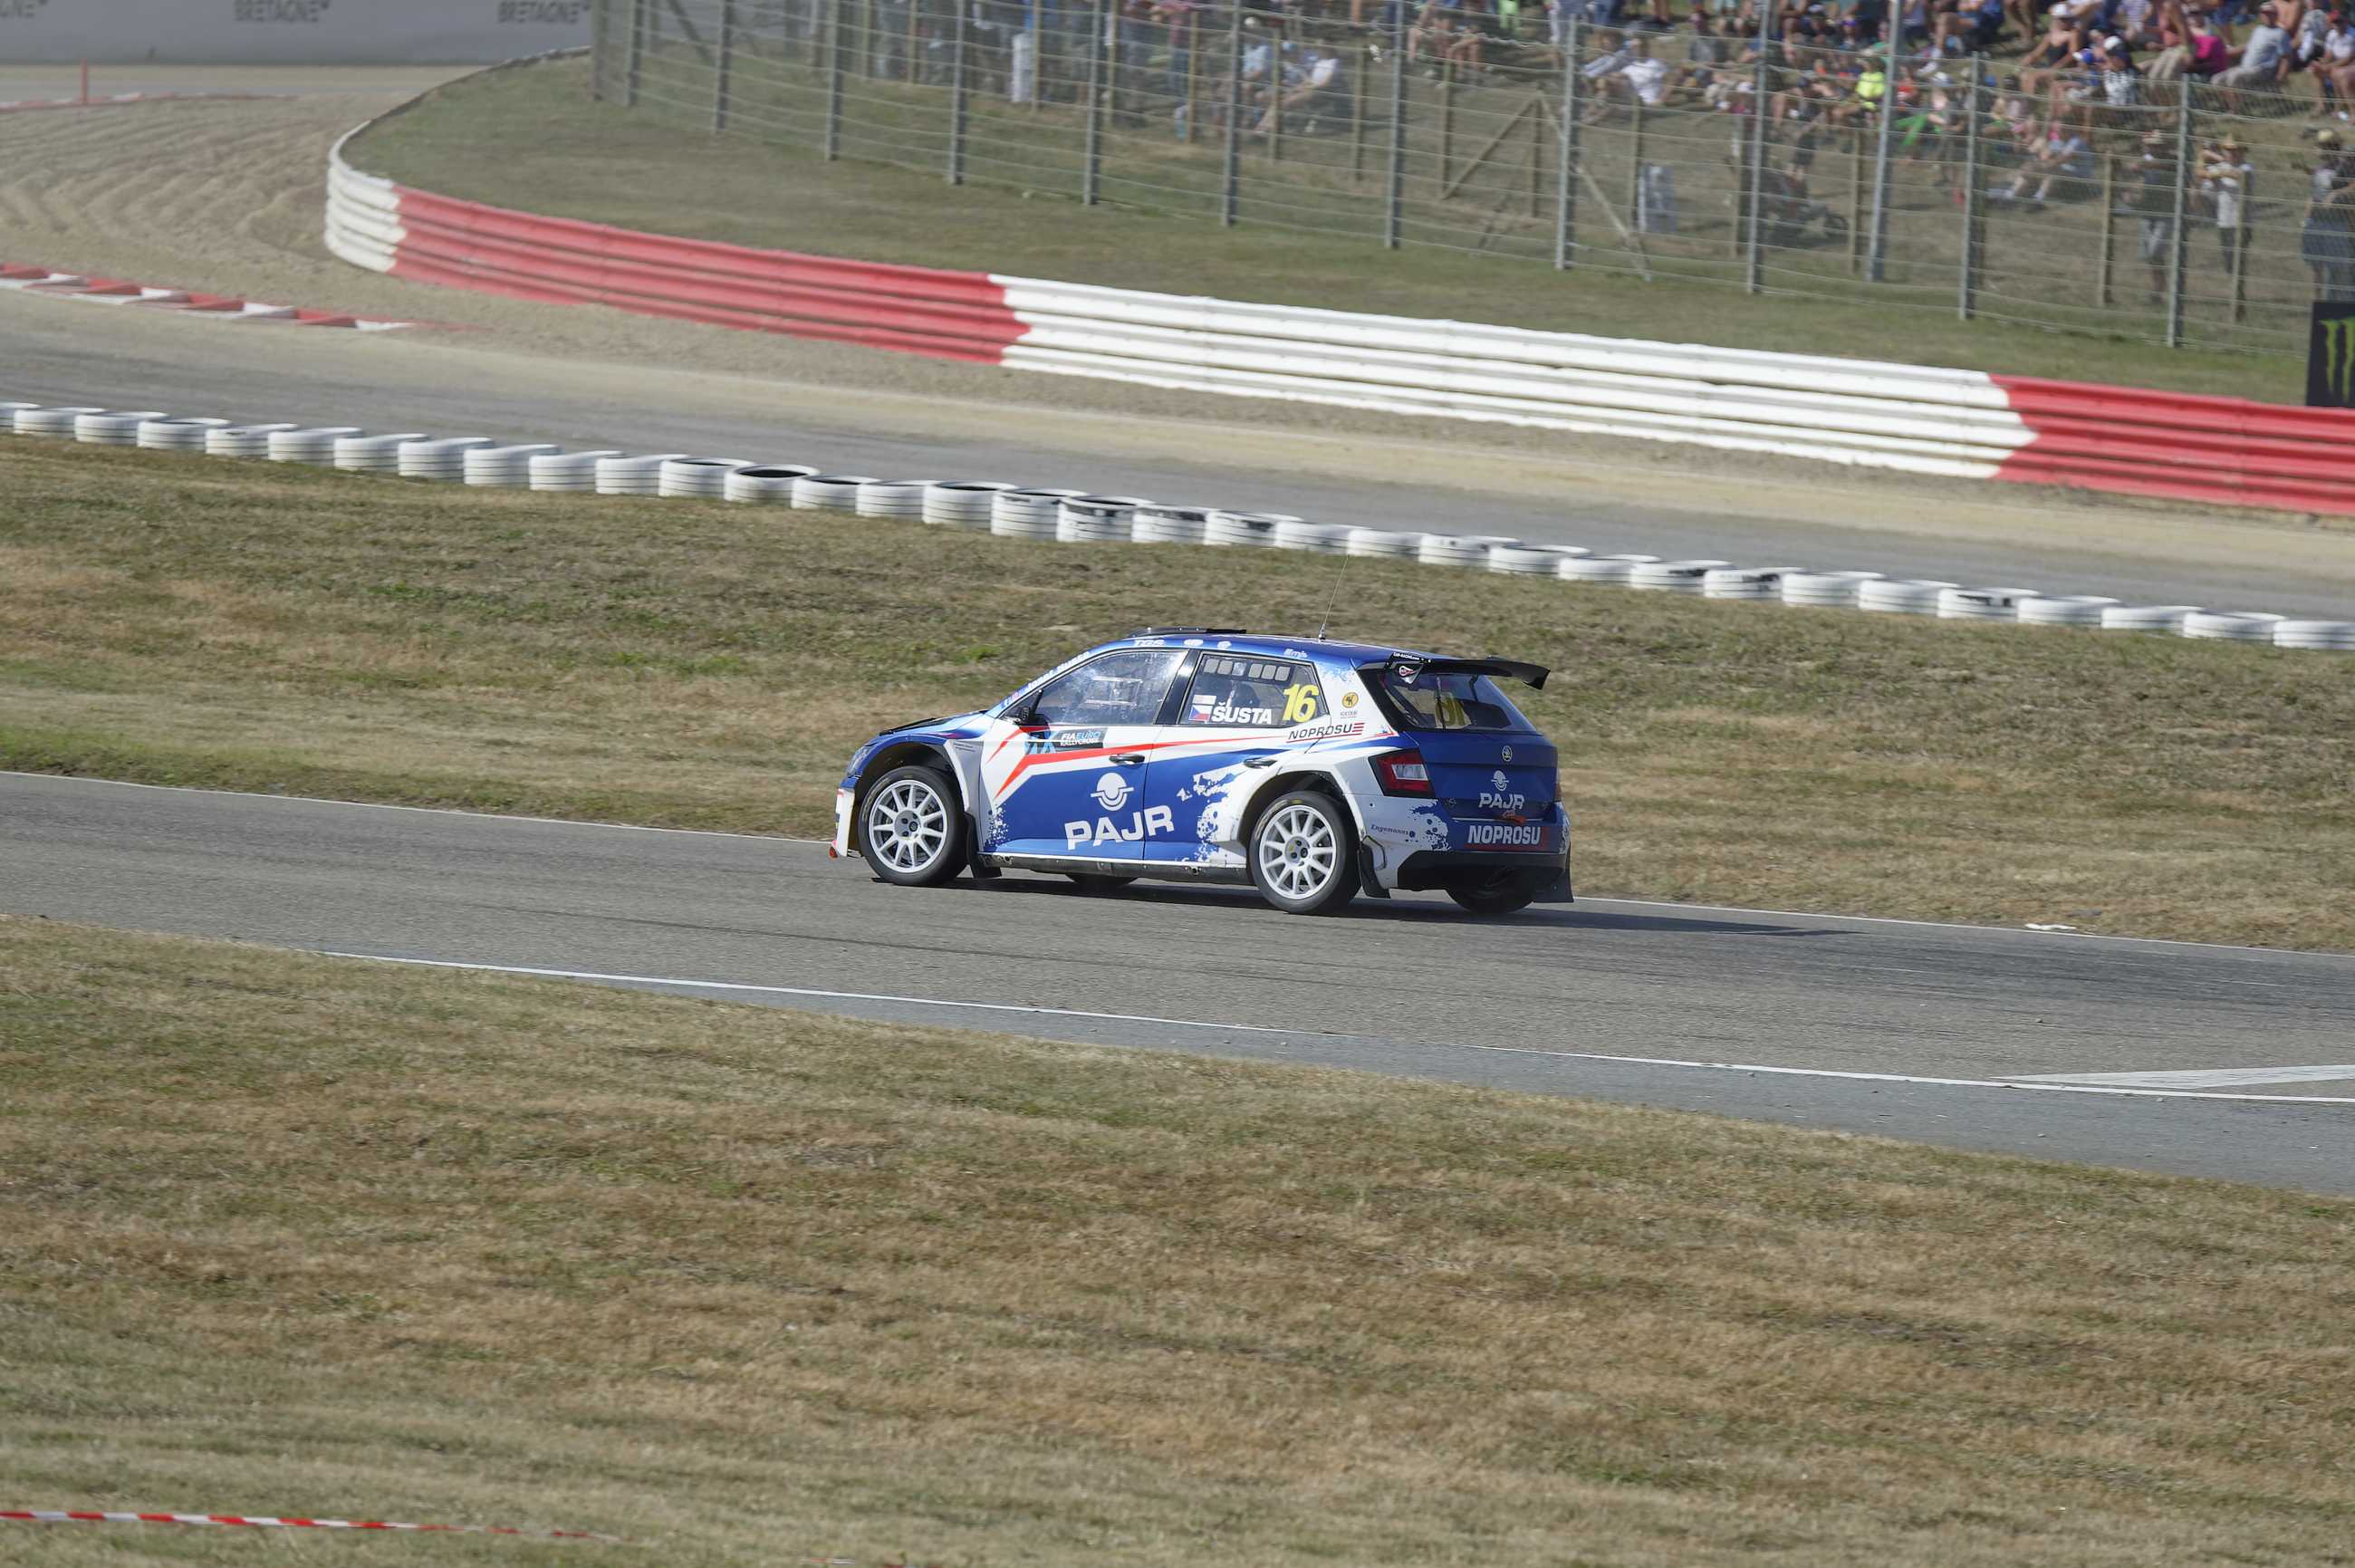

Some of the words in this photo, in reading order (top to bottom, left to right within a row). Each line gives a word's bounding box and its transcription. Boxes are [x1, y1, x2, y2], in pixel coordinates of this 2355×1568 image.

[233, 0, 320, 23] BRETAGNE
[496, 0, 580, 24] BRETAGNE
[1211, 703, 1273, 724] ŠUSTA
[1282, 684, 1320, 723] 16
[1288, 723, 1354, 741] NOPROSU
[1477, 793, 1525, 810] PAJR
[1064, 805, 1175, 851] PAJR
[1467, 825, 1542, 845] NOPROSU
